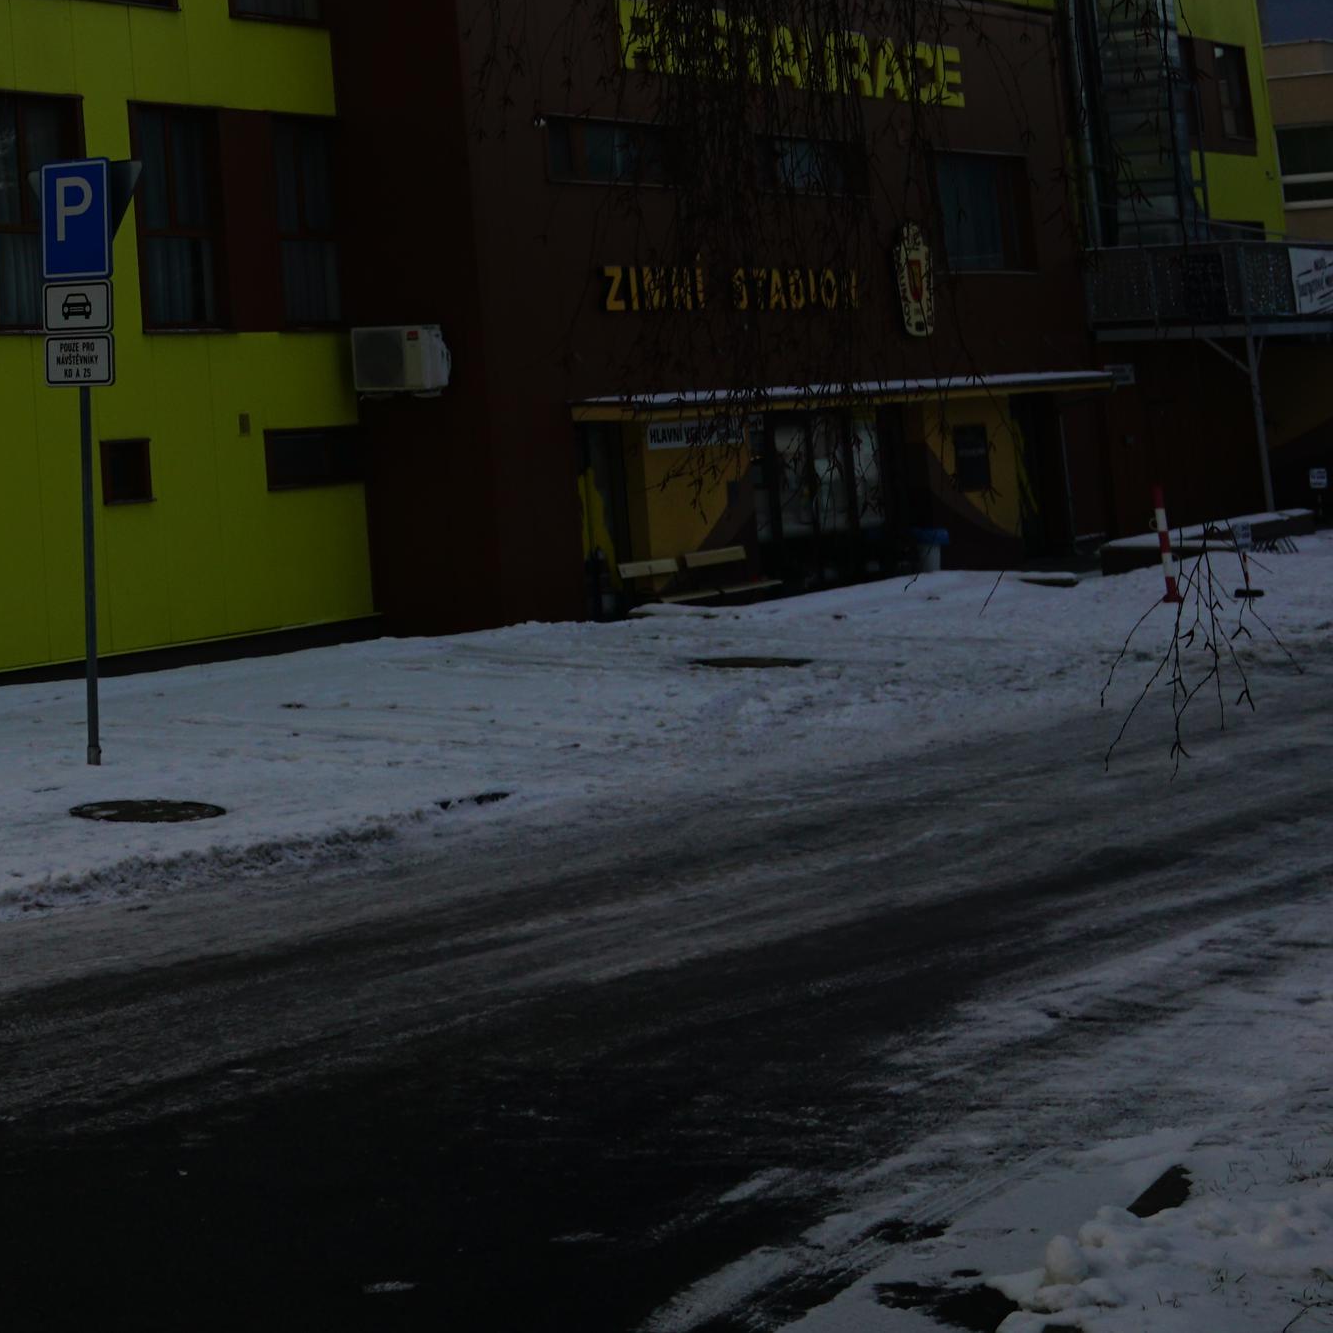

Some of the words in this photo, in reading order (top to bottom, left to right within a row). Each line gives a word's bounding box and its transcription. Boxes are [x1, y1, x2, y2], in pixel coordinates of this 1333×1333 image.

[55, 176, 93, 242] P
[59, 342, 79, 353] POUZE
[82, 341, 95, 352] PRO
[56, 353, 99, 366] NÁVŠTĚVNÍKY
[75, 368, 80, 379] A
[649, 423, 683, 444] HLAVNÍ
